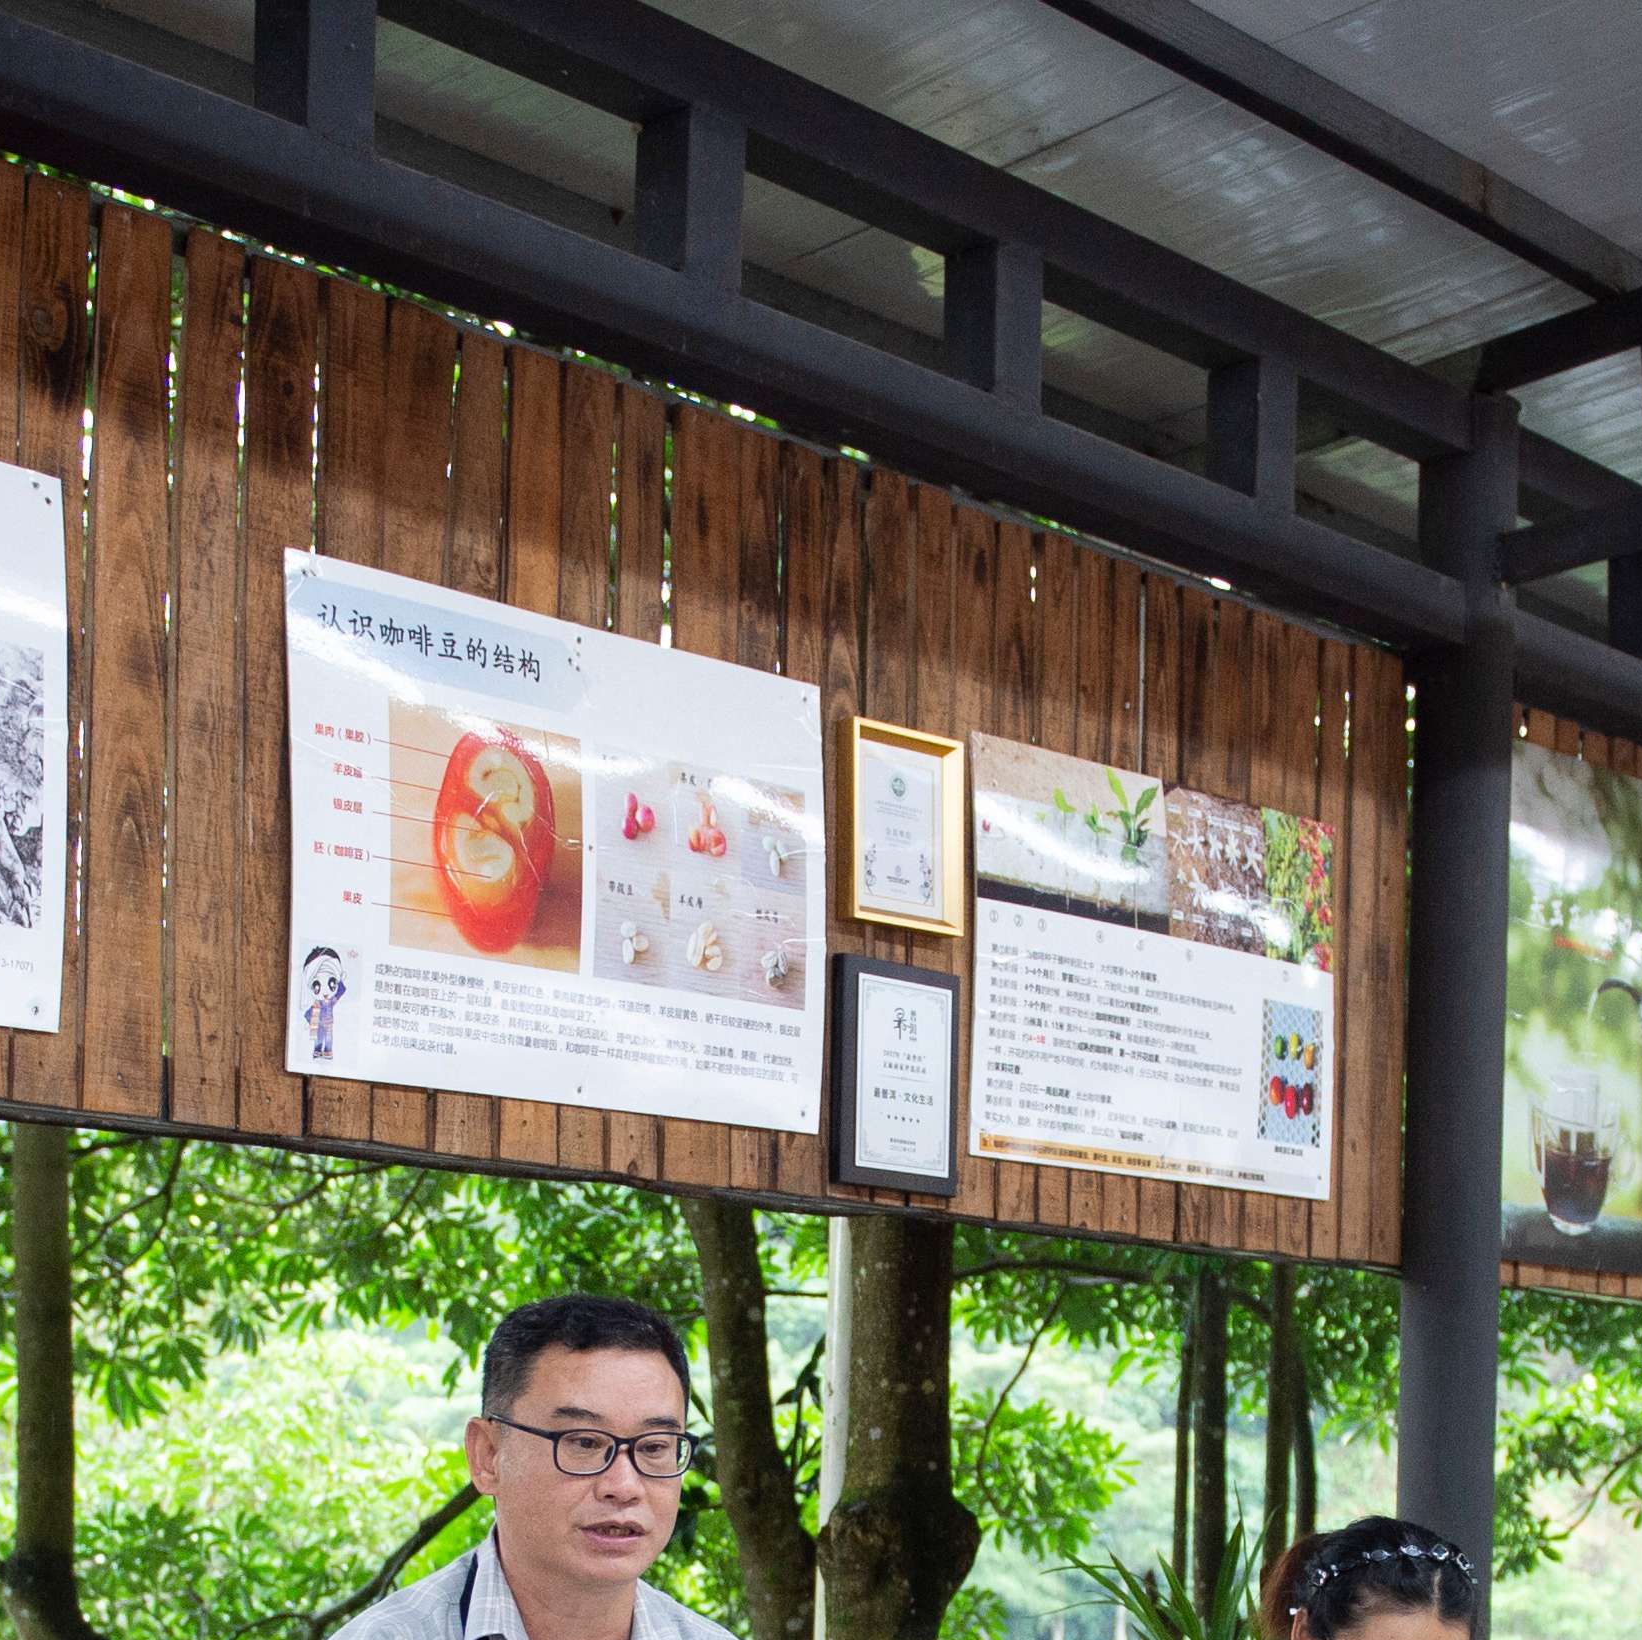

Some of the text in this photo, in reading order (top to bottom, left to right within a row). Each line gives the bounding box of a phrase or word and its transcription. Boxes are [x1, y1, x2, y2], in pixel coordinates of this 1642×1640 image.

[317, 603, 541, 683] 认识咖啡豆的结构
